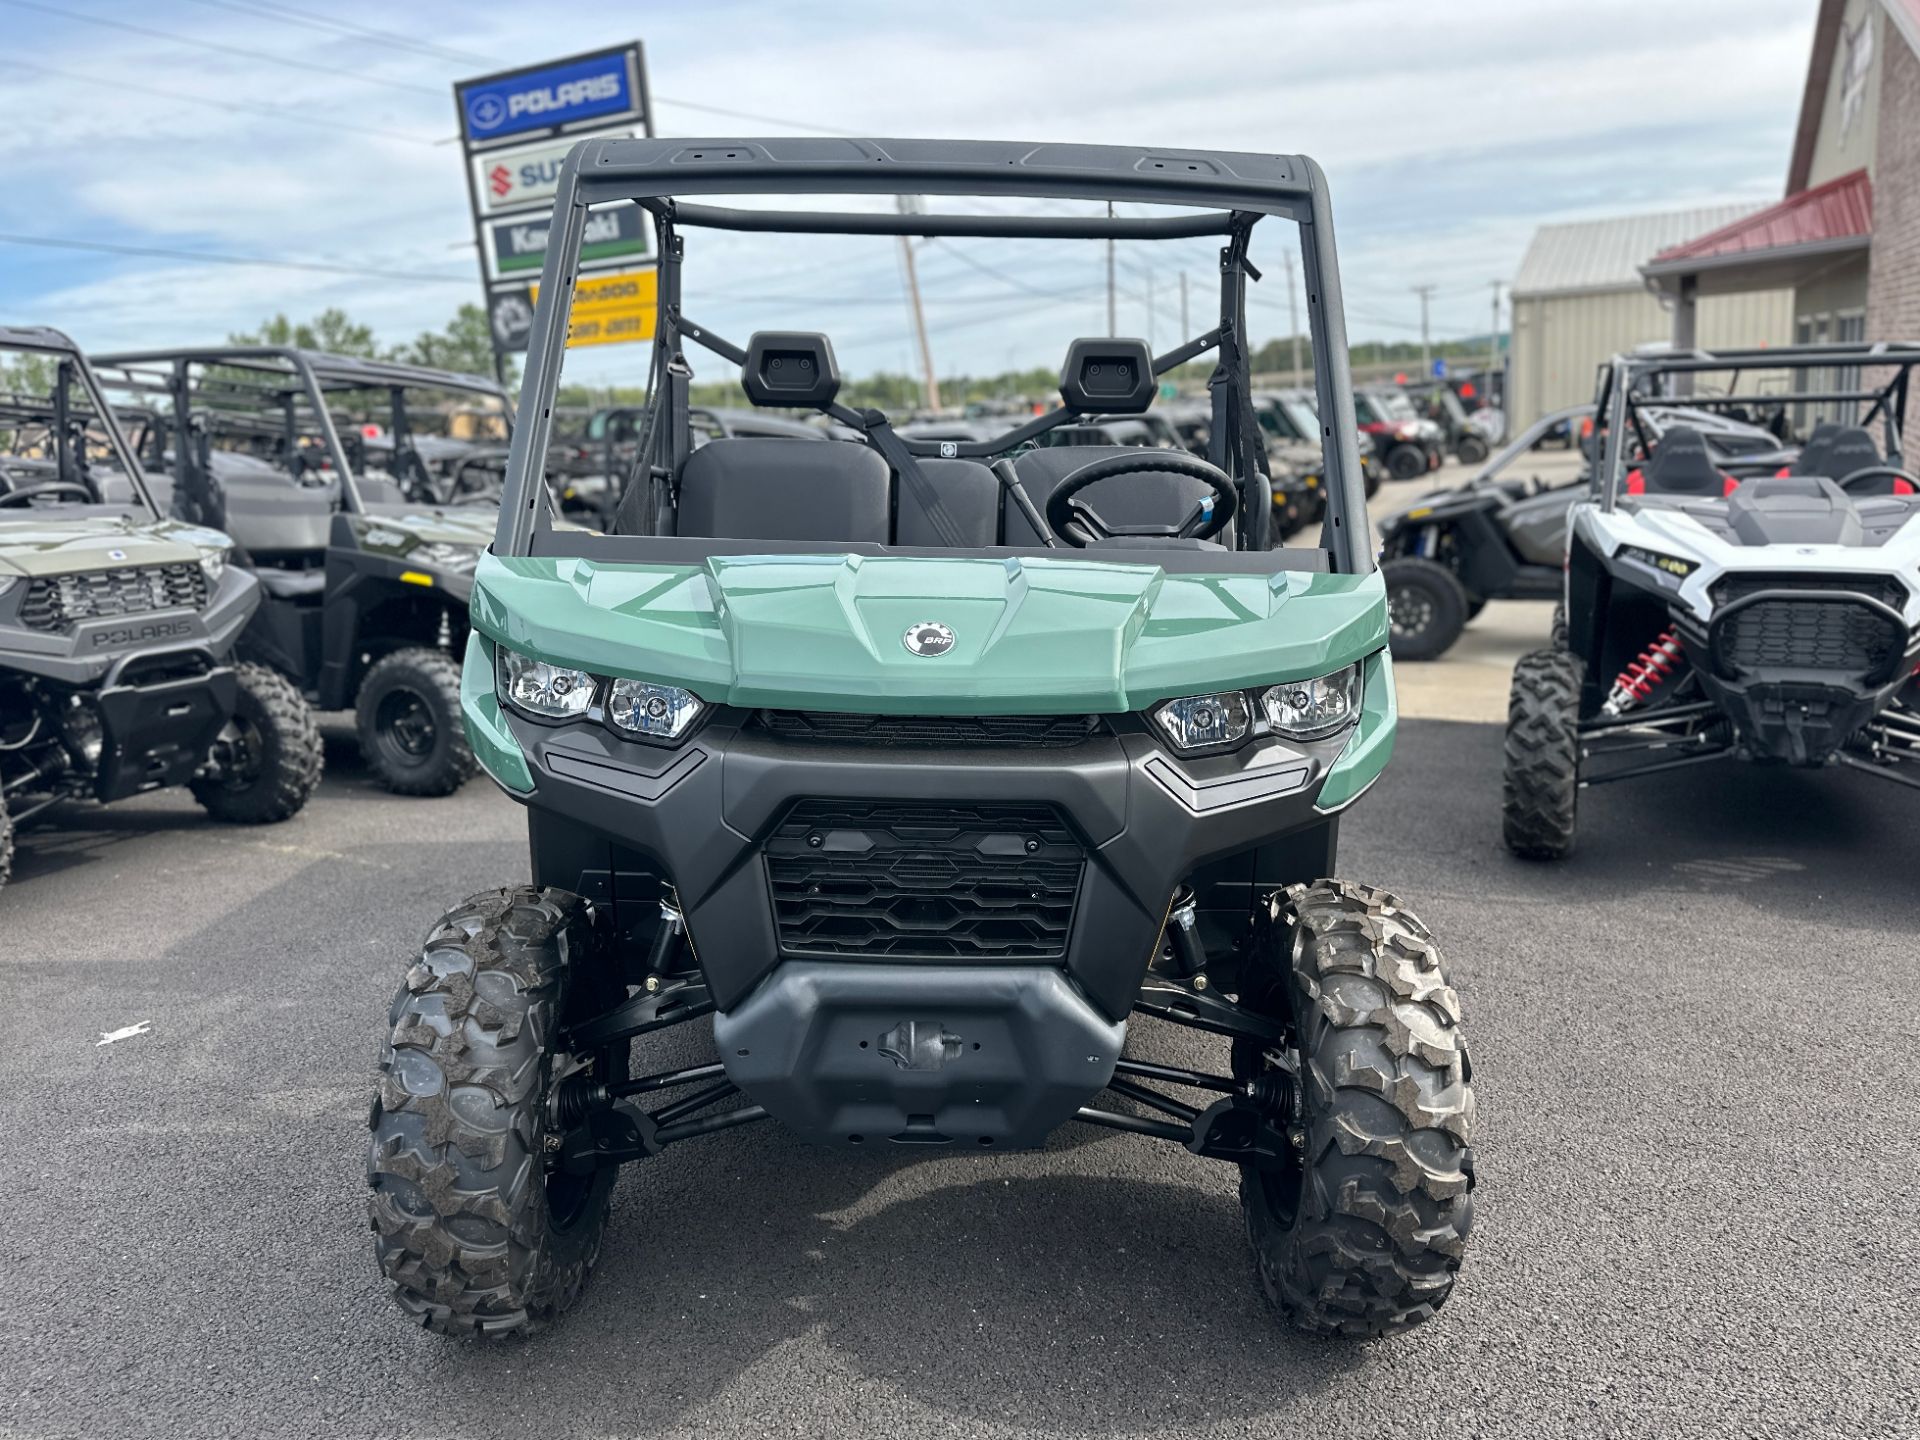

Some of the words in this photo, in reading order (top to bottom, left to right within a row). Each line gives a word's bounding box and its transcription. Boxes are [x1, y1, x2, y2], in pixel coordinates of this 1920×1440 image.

[508, 73, 620, 118] POLARIS
[92, 620, 192, 647] POLARIS
[924, 636, 952, 645] BRP
